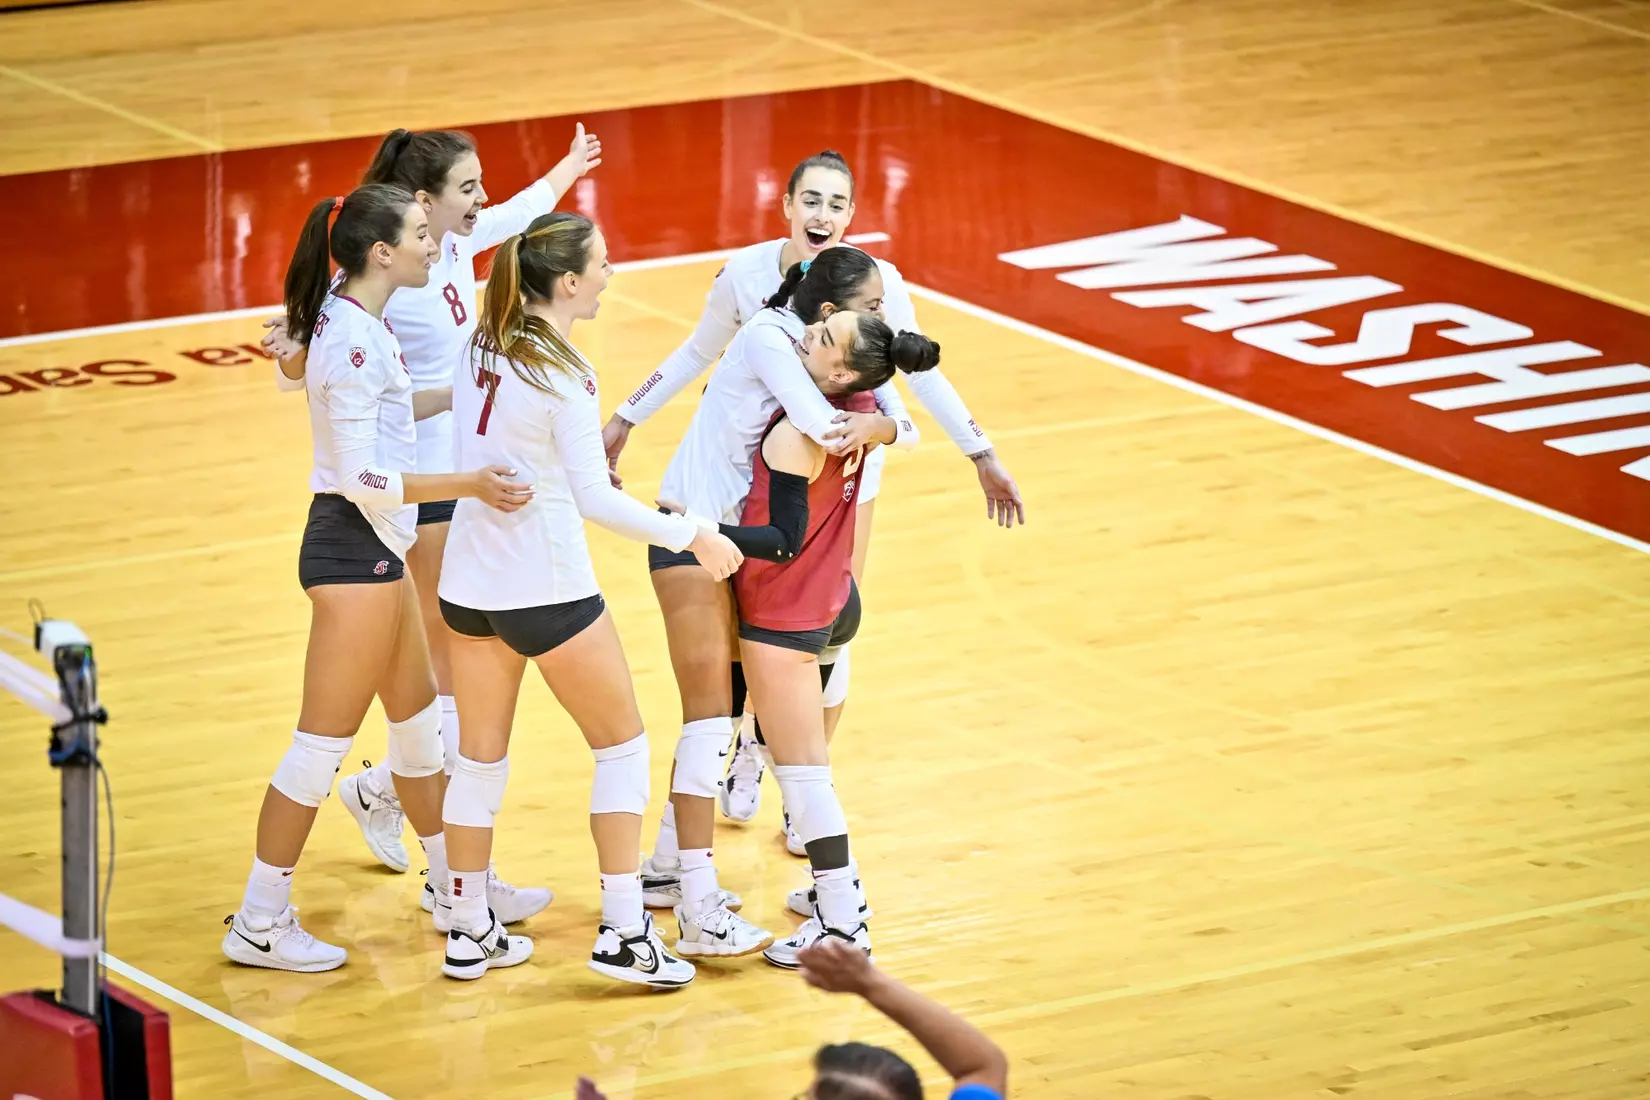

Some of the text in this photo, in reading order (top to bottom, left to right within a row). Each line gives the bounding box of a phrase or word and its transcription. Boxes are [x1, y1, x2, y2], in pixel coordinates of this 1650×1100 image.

[442, 282, 467, 326] 8
[998, 214, 1650, 482] WASHI
[476, 367, 502, 436] 7
[627, 370, 664, 407] COUGARS
[967, 418, 984, 438] WSU
